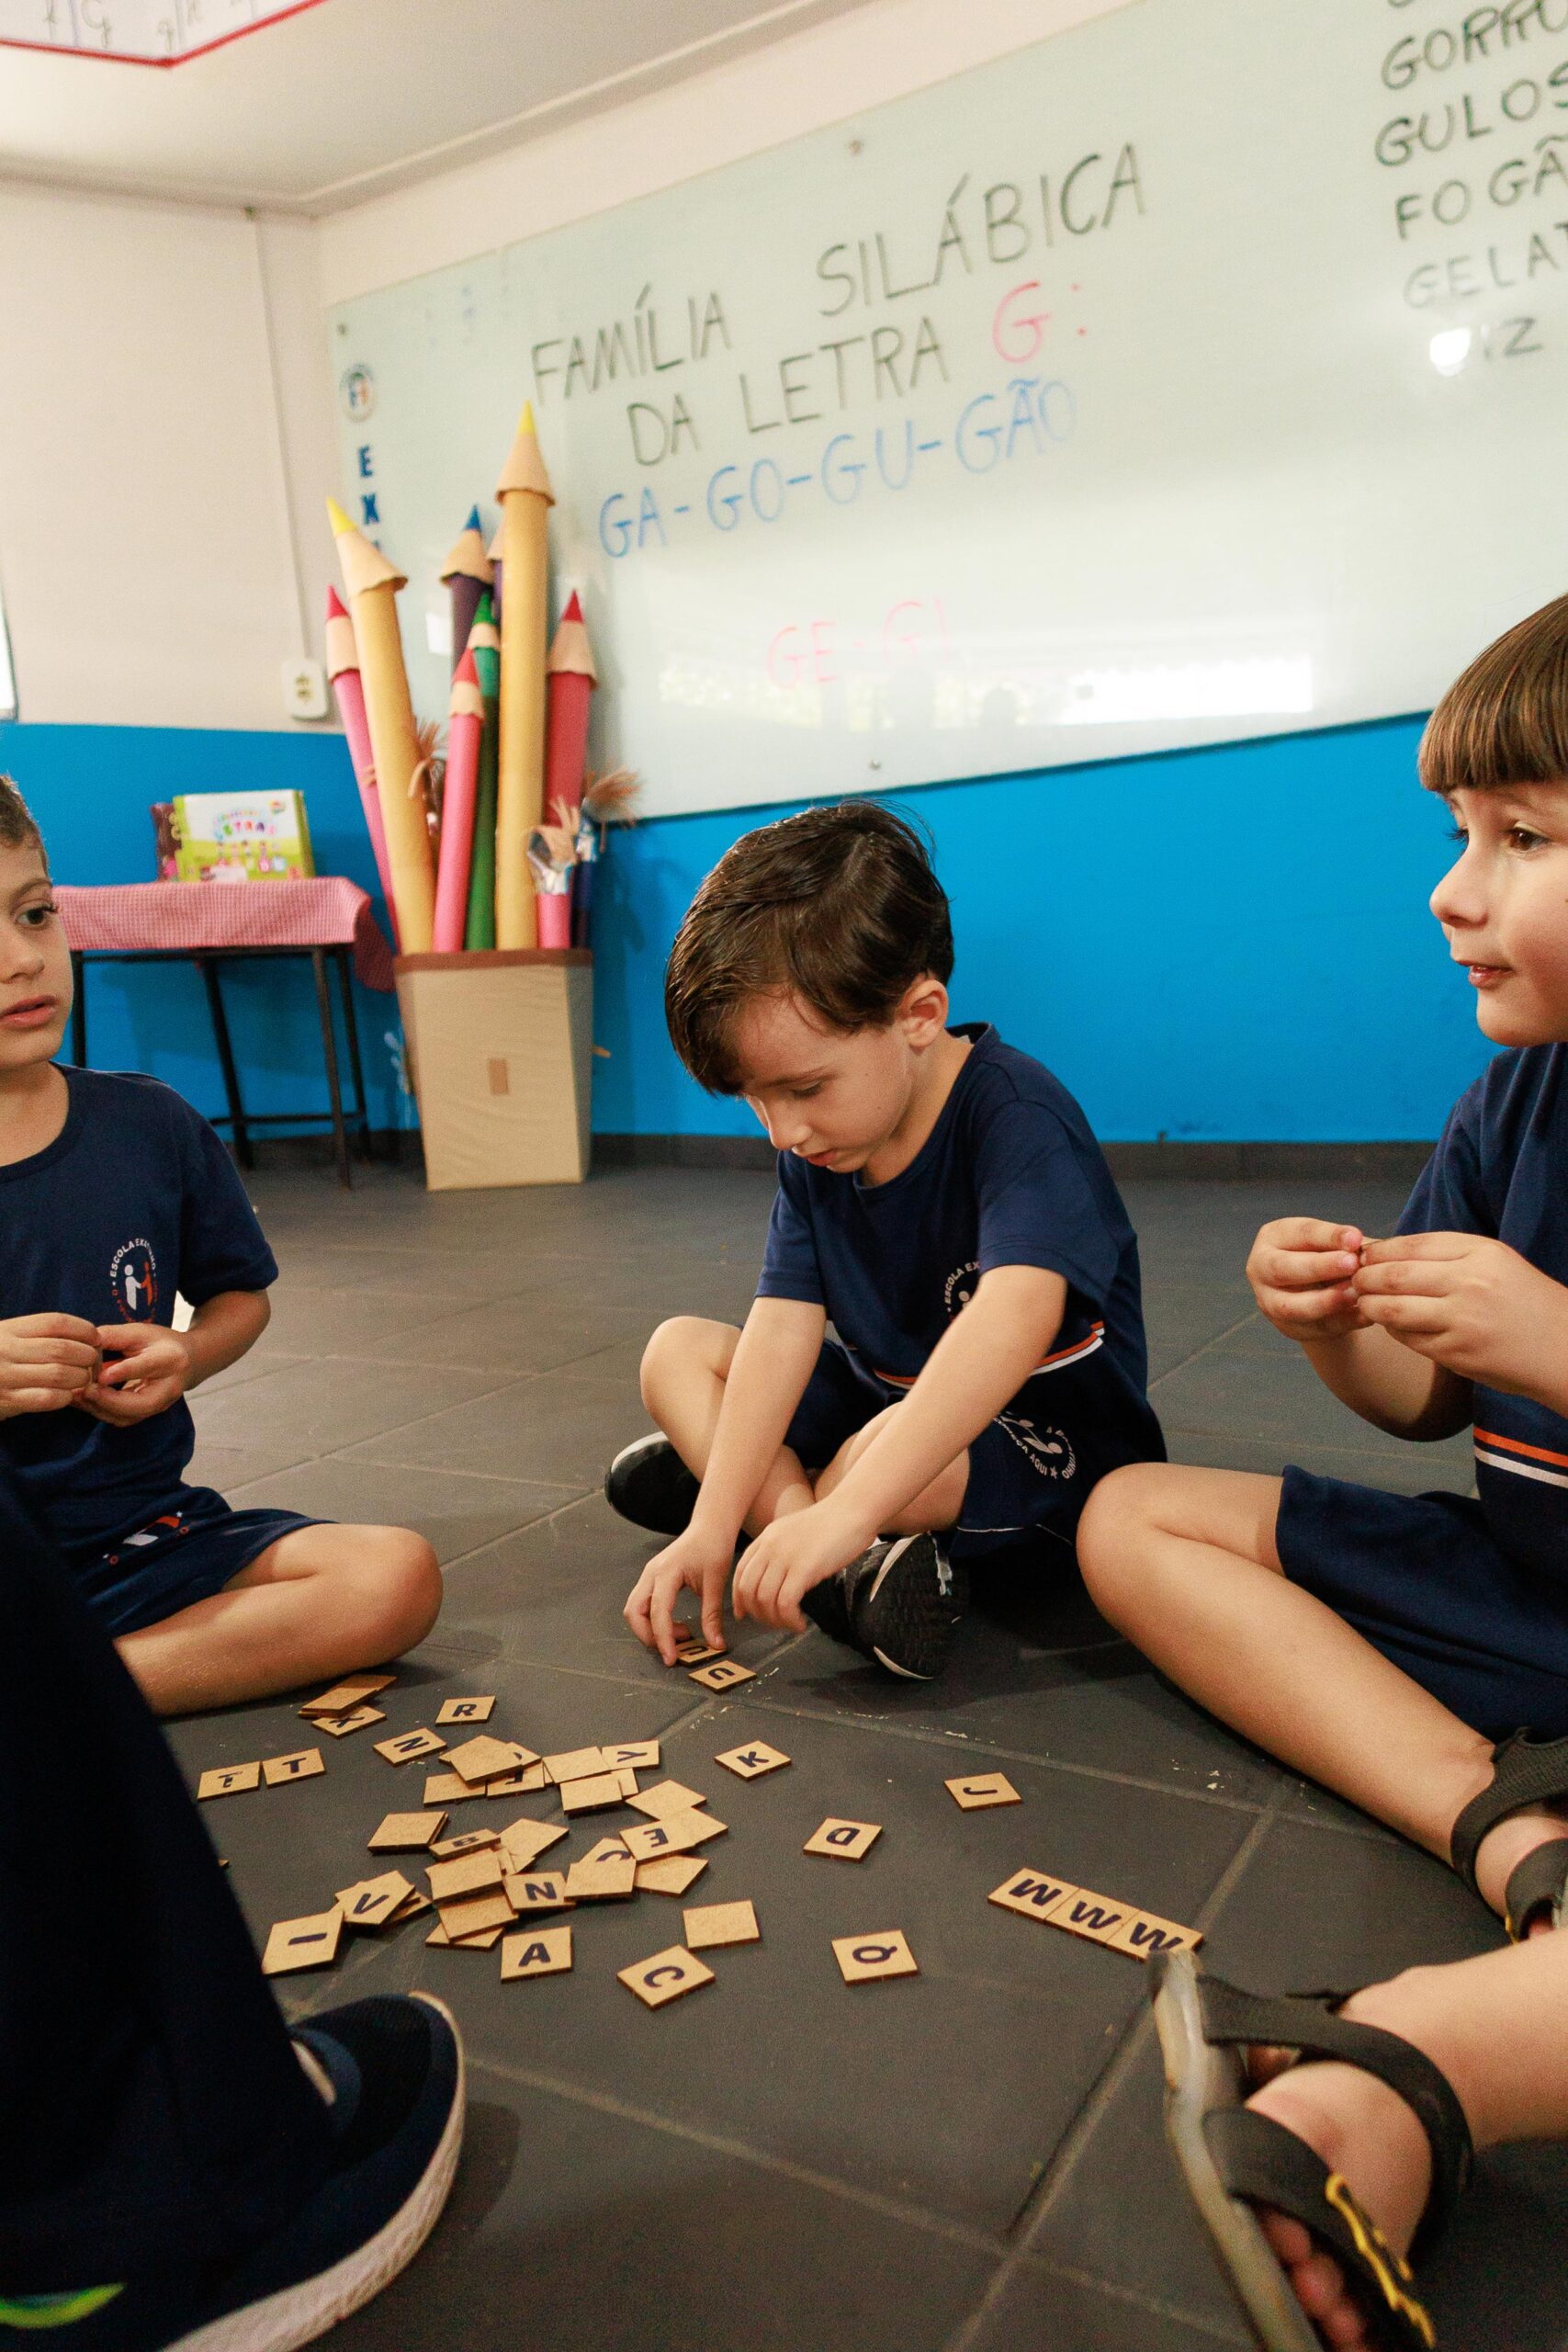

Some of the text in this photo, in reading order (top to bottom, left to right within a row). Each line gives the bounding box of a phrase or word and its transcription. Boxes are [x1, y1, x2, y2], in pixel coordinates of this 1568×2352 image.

[532, 142, 1145, 405] FAMÍLIA SILÁBICA
[626, 393, 701, 466] DA
[739, 316, 950, 435] LETRA
[109, 1240, 135, 1278] ESCOLA
[944, 1268, 965, 1305] ESCOLA
[1029, 1453, 1048, 1476] AQUI
[453, 1703, 478, 1718] R
[282, 1756, 307, 1774] T
[616, 1750, 648, 1763] Y
[737, 1749, 770, 1768] K
[962, 1786, 998, 1796] J
[643, 1826, 670, 1849] E
[826, 1826, 861, 1847] D
[525, 1882, 558, 1902] N
[353, 1893, 389, 1915] V
[518, 1941, 552, 1968] A
[852, 1945, 898, 1964] Q
[643, 1965, 685, 1988] C
